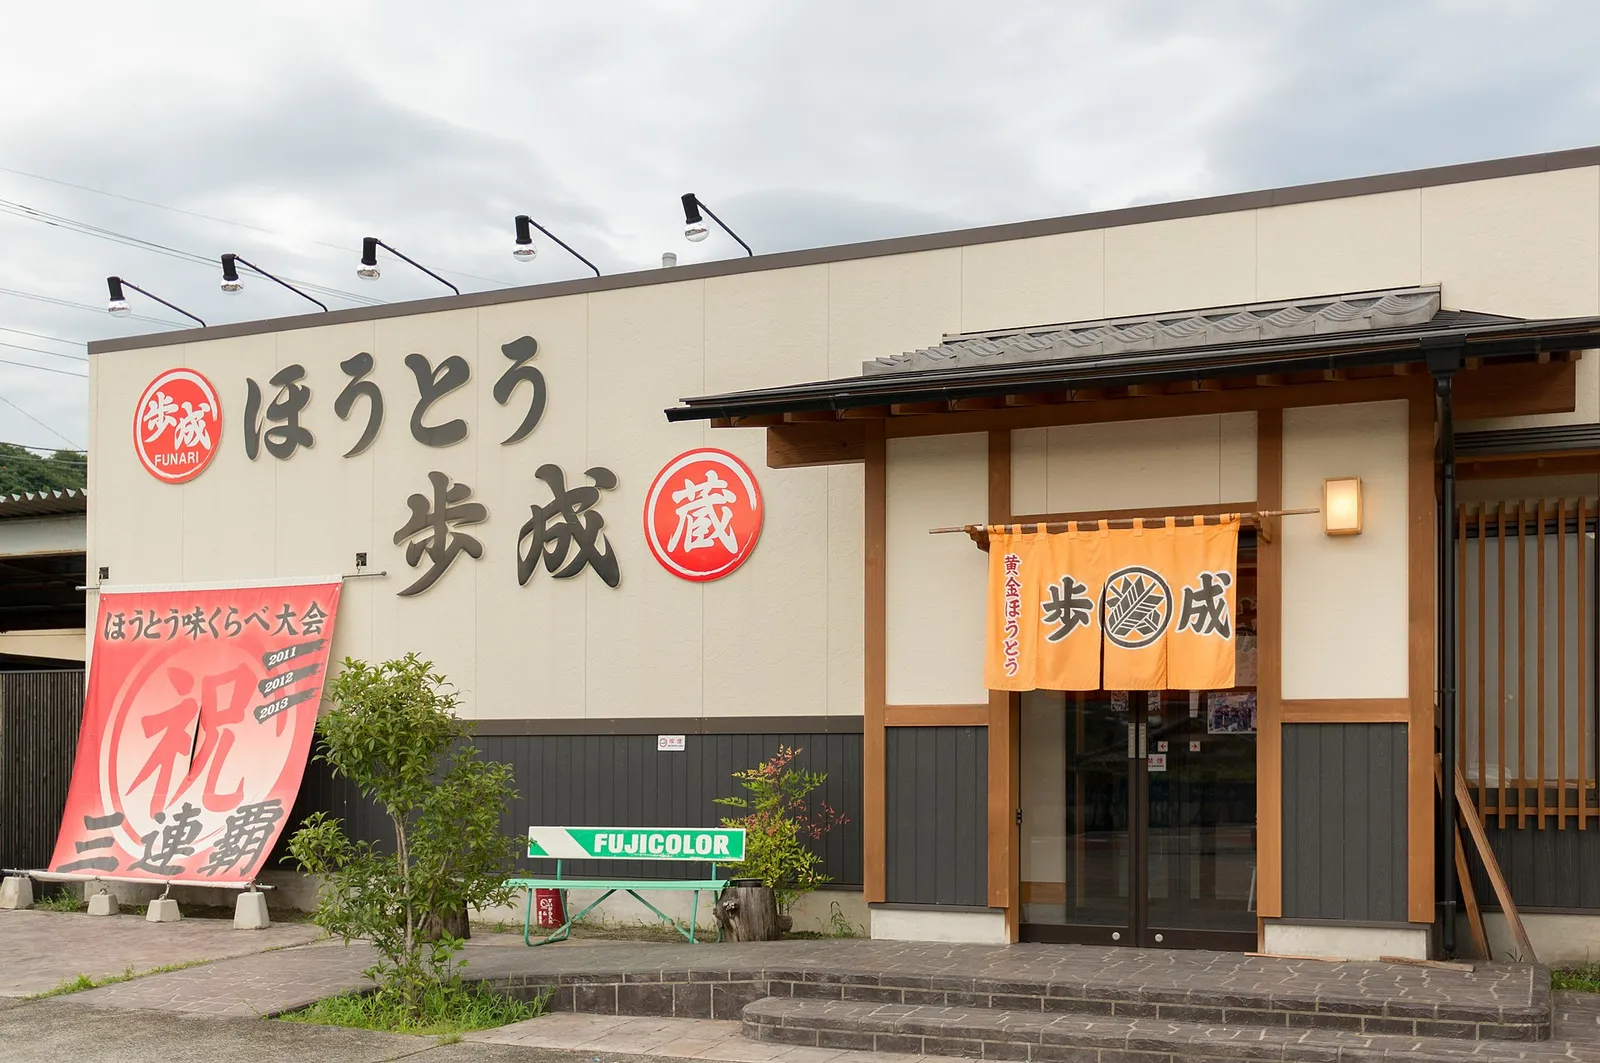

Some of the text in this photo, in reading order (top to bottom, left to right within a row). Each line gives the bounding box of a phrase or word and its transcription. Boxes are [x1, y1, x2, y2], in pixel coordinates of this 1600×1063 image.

[142, 390, 213, 452] 歩成
[243, 334, 548, 461] ほうとう
[153, 450, 199, 468] FUNARI
[393, 463, 622, 598] 歩成
[666, 469, 740, 556] 蔵
[103, 600, 329, 642] ほうとう味くらべ大会
[1003, 554, 1022, 677] 黄金ほうとう
[1041, 573, 1232, 642] 歩成
[263, 671, 294, 694] 2012
[267, 646, 297, 667] 2011
[124, 662, 259, 820] 祝
[258, 697, 289, 720] 2013
[55, 798, 285, 877] 三連覇
[593, 832, 730, 856] FUJICOLOR
